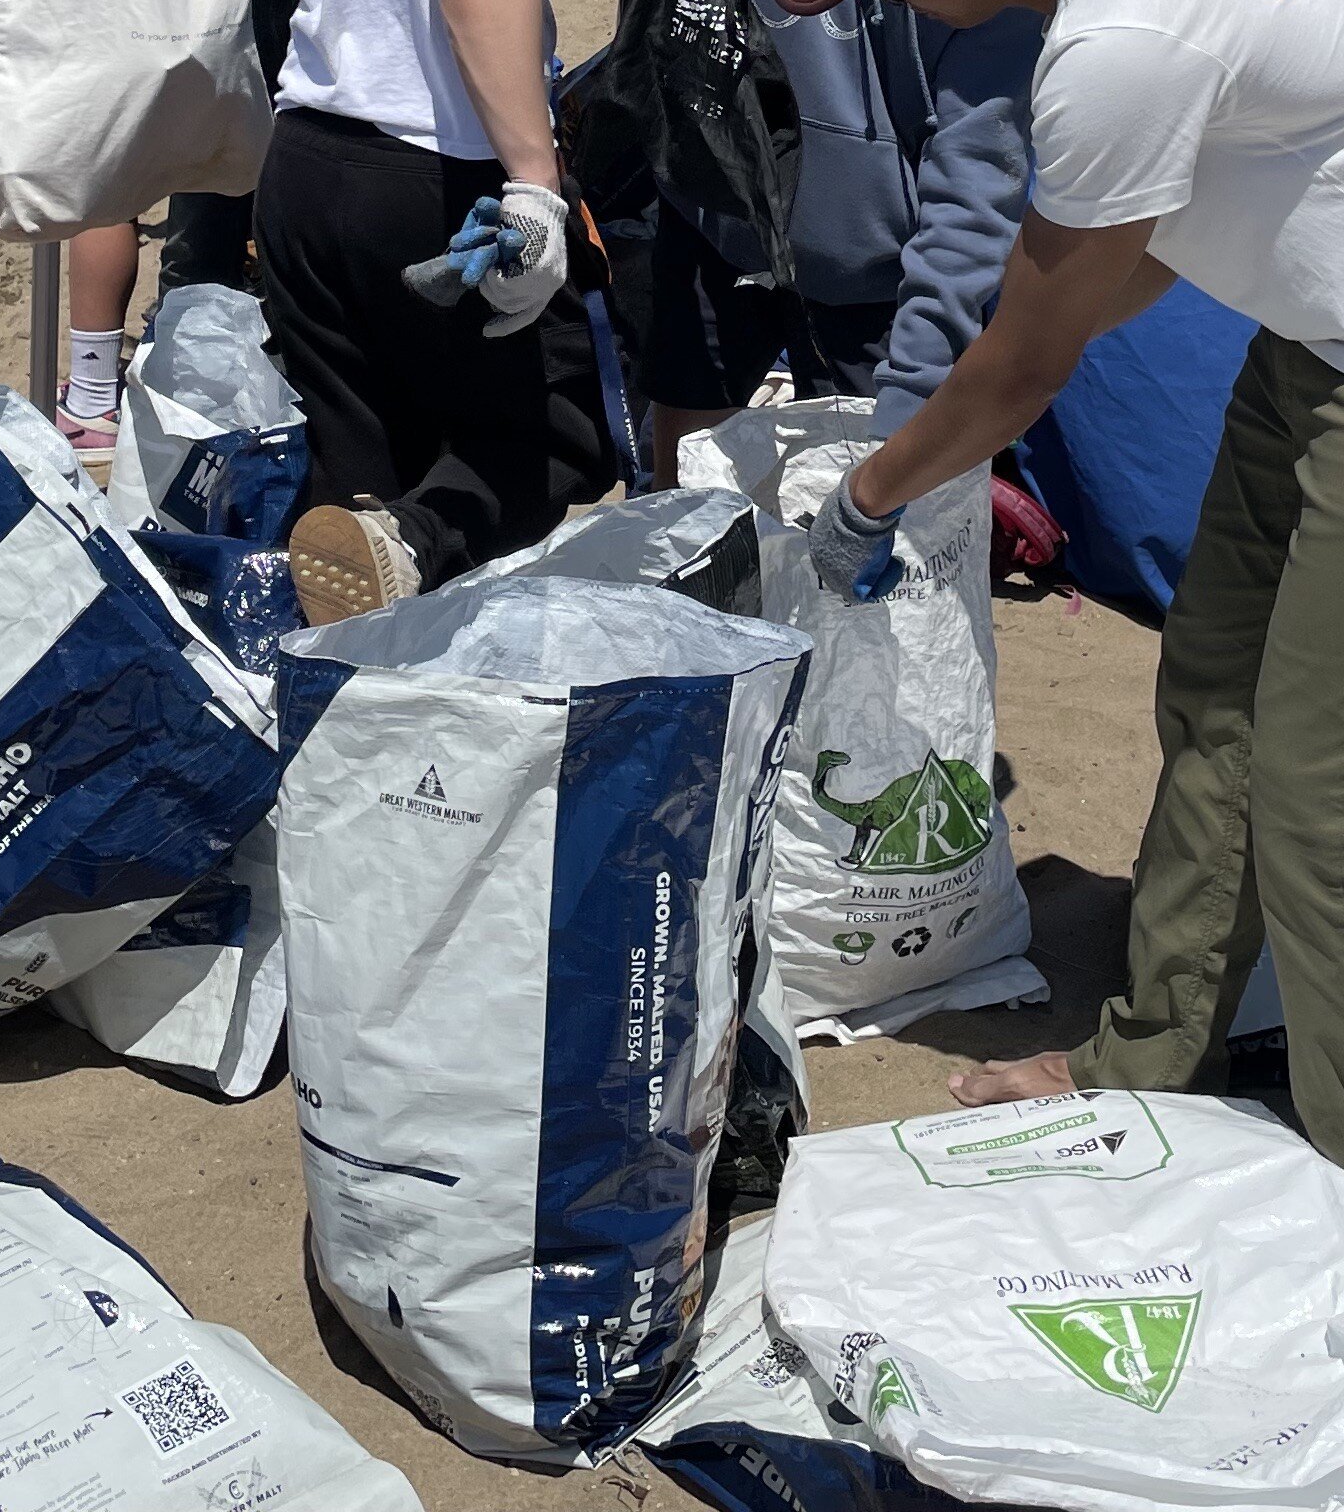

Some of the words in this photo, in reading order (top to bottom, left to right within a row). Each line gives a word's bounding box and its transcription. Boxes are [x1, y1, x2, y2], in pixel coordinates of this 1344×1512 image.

[10, 814, 33, 837] THE
[31, 793, 55, 815] USA
[380, 793, 404, 806] GREAT
[407, 798, 442, 817] WESTERN
[444, 808, 482, 823] MALTING
[654, 871, 670, 969] GROWN.
[846, 912, 890, 923] FOSSIL
[896, 909, 926, 921] FREE
[1, 977, 45, 997] PUR
[629, 947, 646, 1012] SINCE
[649, 974, 665, 1070] MALTED.
[628, 1016, 644, 1062] 1934
[648, 1076, 662, 1132] USA.
[1028, 1113, 1093, 1139] CANADIAN
[953, 1132, 1025, 1155] CUSTOMERS
[1056, 1138, 1099, 1158] BSG
[1032, 1270, 1124, 1292] MALTING
[1146, 1305, 1182, 1319] 1847
[574, 1315, 590, 1389] PODUCT
[12, 1453, 41, 1472] Idaho
[72, 1422, 95, 1443] Malt
[16, 1440, 30, 1454] out
[34, 1429, 56, 1447] more
[162, 1468, 191, 1485] PACKED
[191, 1460, 207, 1471] AND
[206, 1436, 252, 1462] DISTRIBUTED
[251, 1429, 261, 1438] BY
[256, 1484, 283, 1503] MALT
